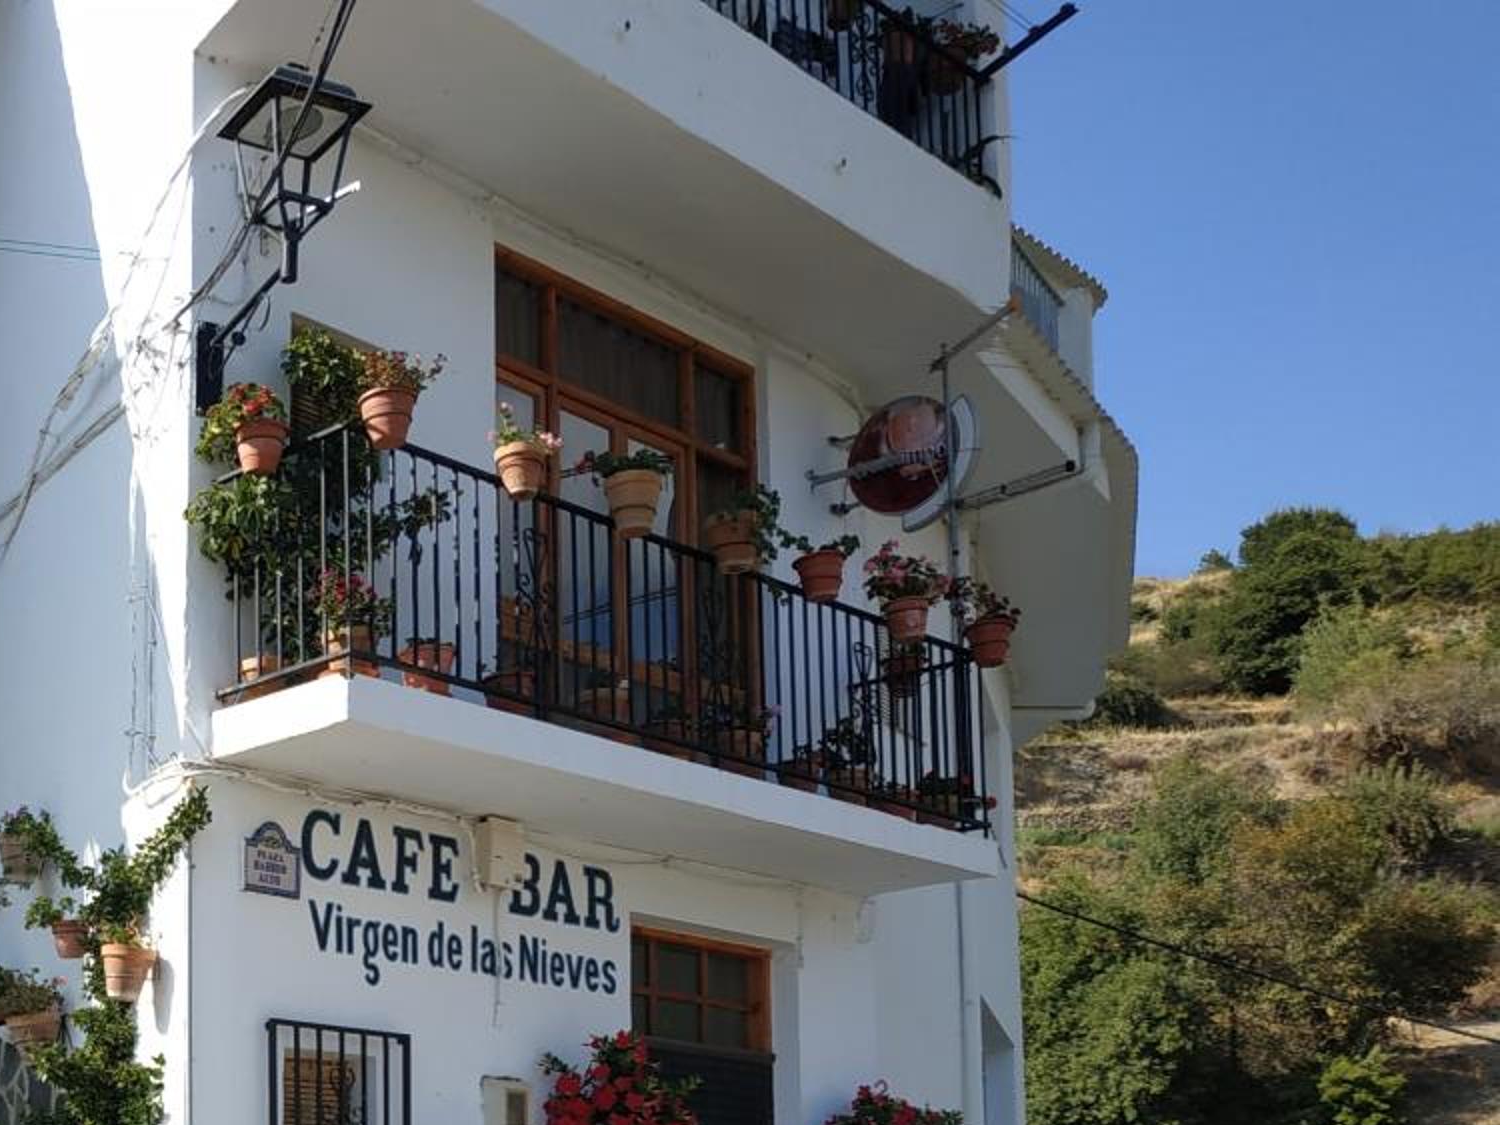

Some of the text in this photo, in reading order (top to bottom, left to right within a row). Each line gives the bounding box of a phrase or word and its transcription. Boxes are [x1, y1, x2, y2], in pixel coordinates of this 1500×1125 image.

[257, 849, 285, 862] PLAZA
[301, 809, 621, 934] CAFE BAR
[308, 899, 617, 995] Virgen de las Nieves
